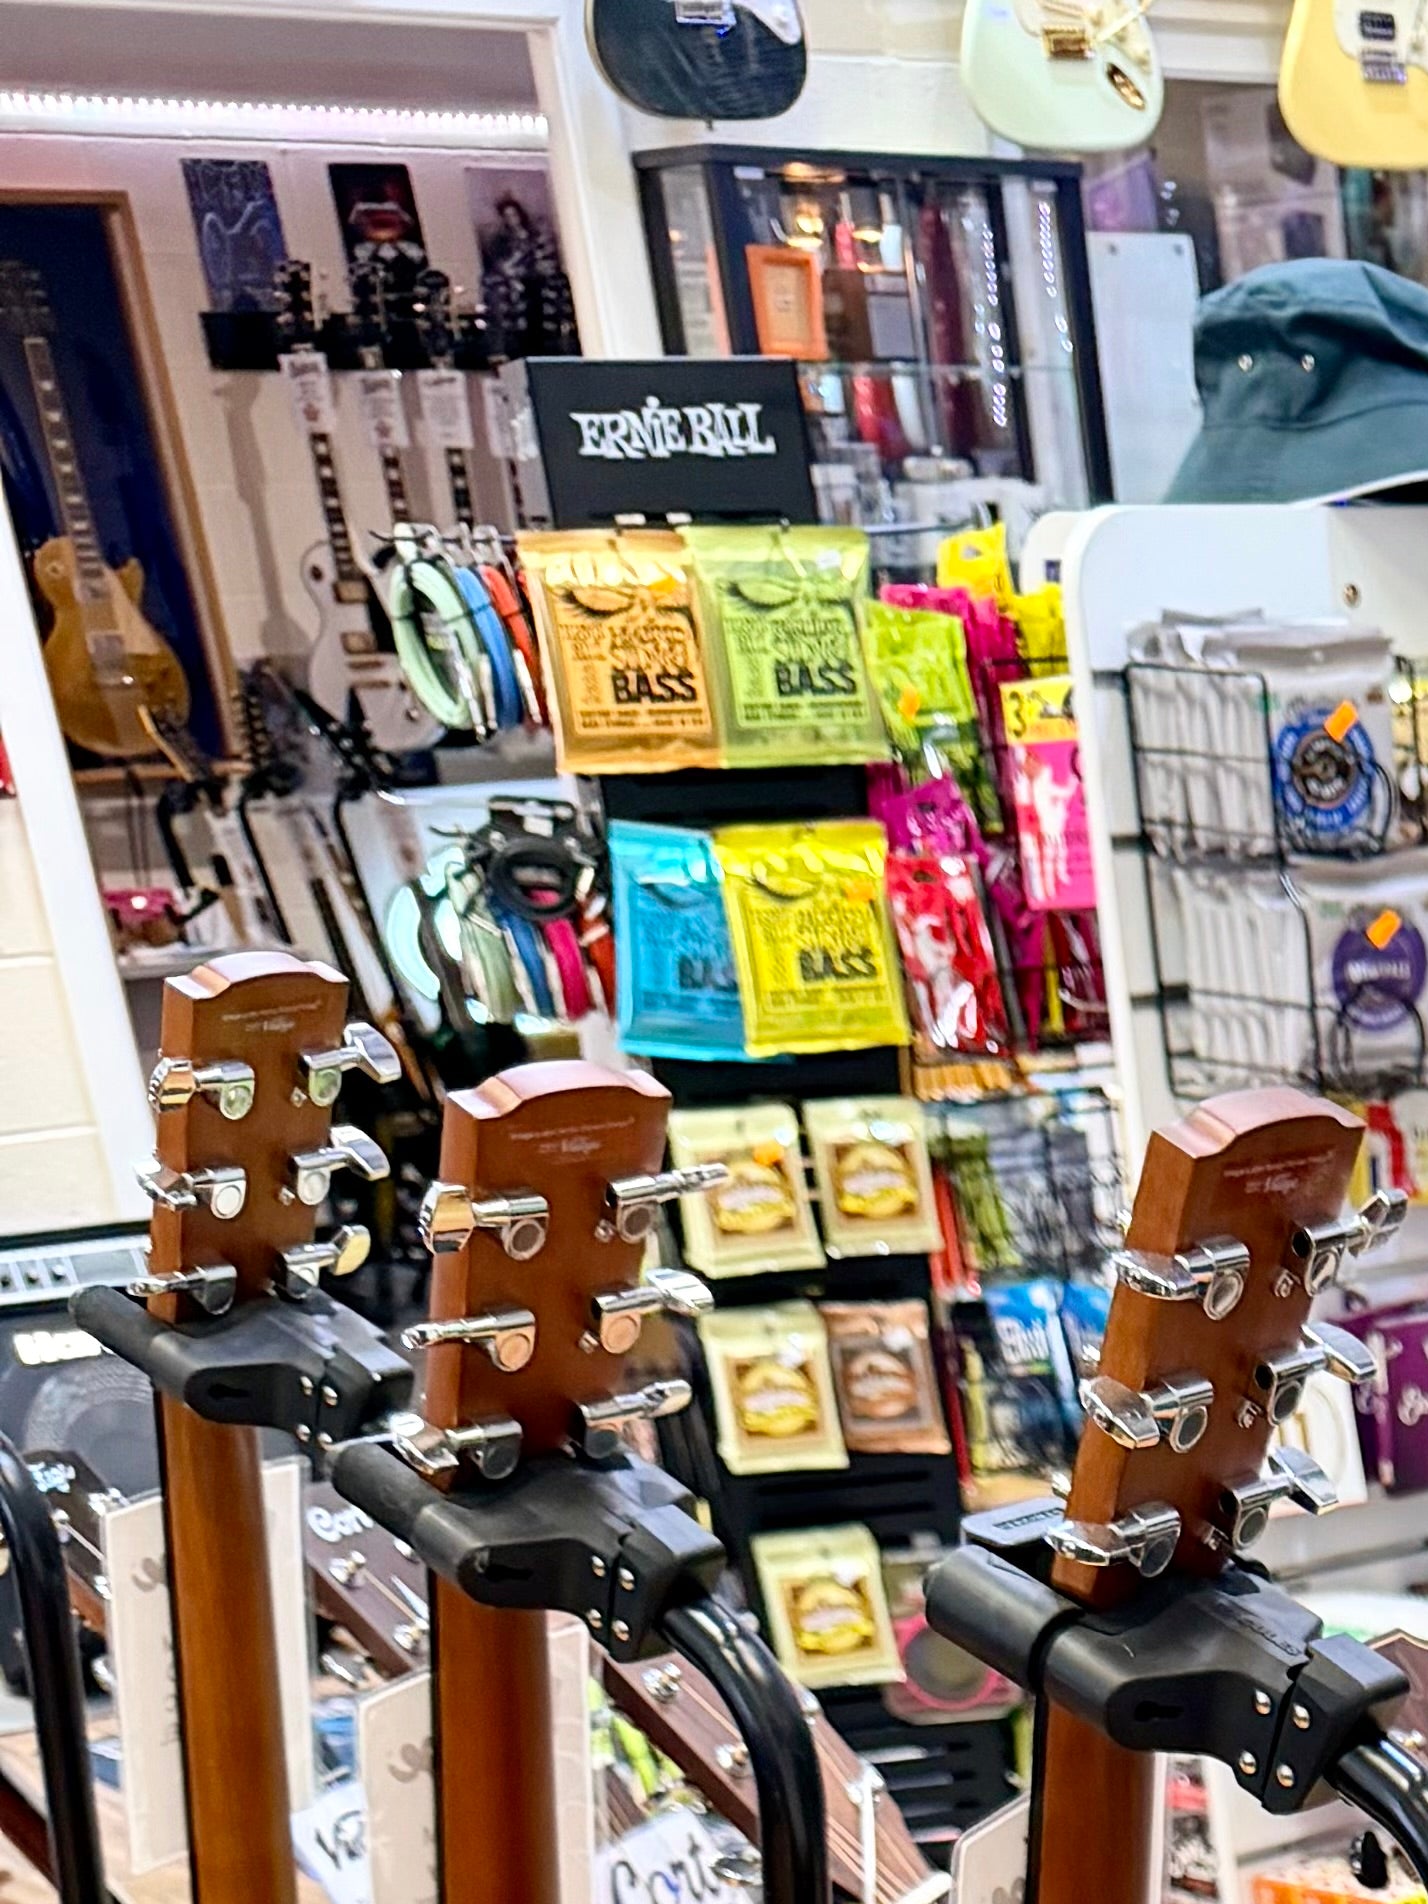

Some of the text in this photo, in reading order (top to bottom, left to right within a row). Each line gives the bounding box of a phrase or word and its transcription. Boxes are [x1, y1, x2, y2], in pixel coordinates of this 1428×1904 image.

[570, 396, 777, 459] ERNIE BALL
[611, 670, 697, 705] BASS
[775, 661, 856, 697] BASS
[800, 947, 877, 983] BASS
